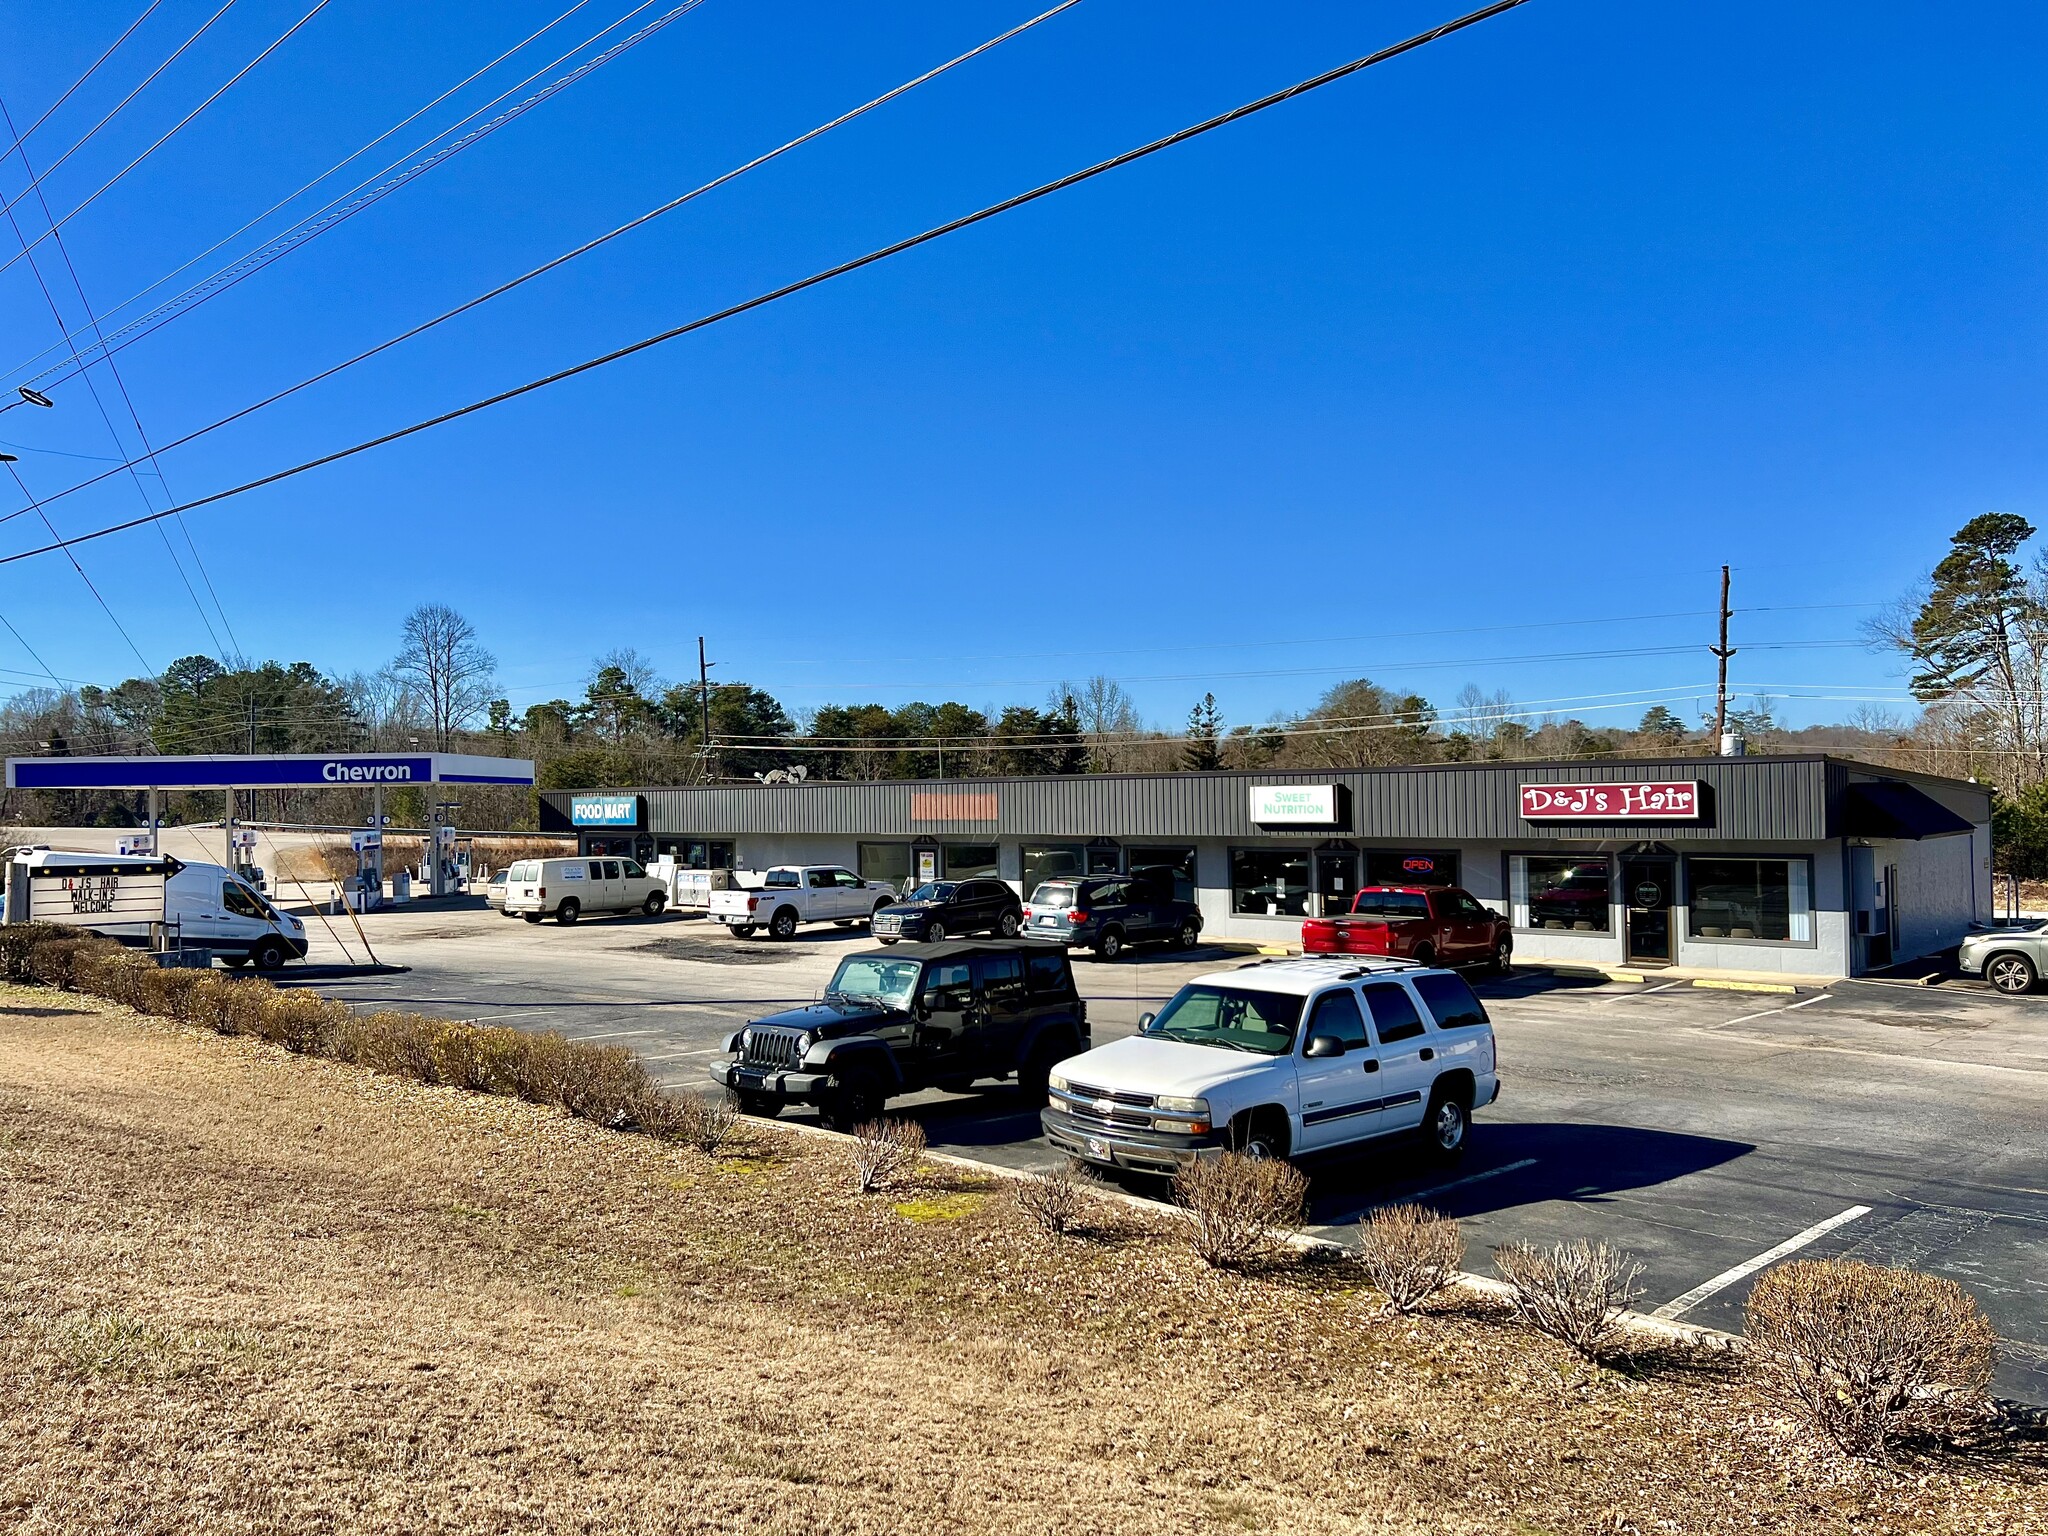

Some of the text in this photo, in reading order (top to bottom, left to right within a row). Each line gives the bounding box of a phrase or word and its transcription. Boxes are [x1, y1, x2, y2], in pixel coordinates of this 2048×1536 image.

[322, 762, 411, 781] Chevron
[1274, 791, 1312, 803] SWEET
[1523, 785, 1693, 815] D&J's Hair
[575, 803, 631, 820] FOOD MART
[1263, 803, 1324, 815] NUTRITION
[1403, 860, 1434, 870] OPEN
[100, 876, 119, 888] HAIR
[70, 889, 116, 901] WALK-IN'S
[72, 900, 113, 913] WELCOME
